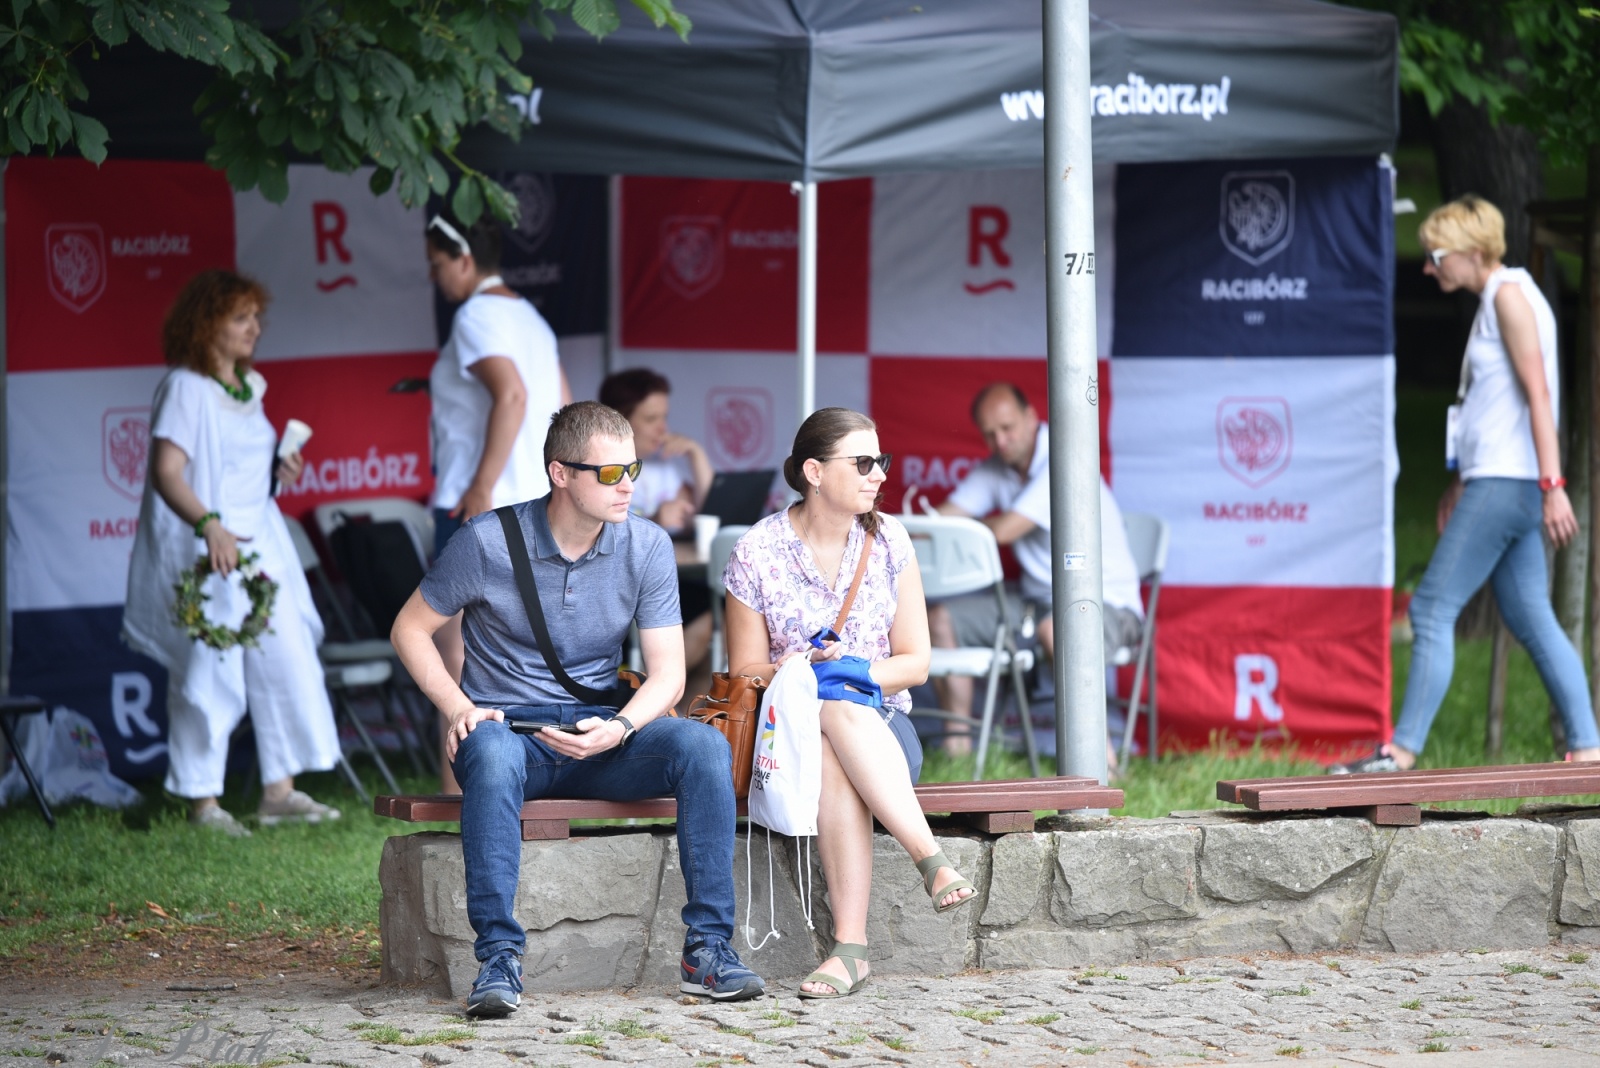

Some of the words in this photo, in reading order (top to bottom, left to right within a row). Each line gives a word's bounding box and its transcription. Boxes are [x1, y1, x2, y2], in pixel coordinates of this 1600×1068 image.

[1001, 72, 1231, 121] wwraciborz.pl
[312, 200, 353, 265] R
[967, 205, 1014, 268] R
[1202, 272, 1308, 301] RACIBÓRZ
[89, 517, 139, 540] RACI
[1204, 498, 1308, 522] RACIBÓRZ
[112, 671, 161, 738] R
[1234, 653, 1284, 722] R
